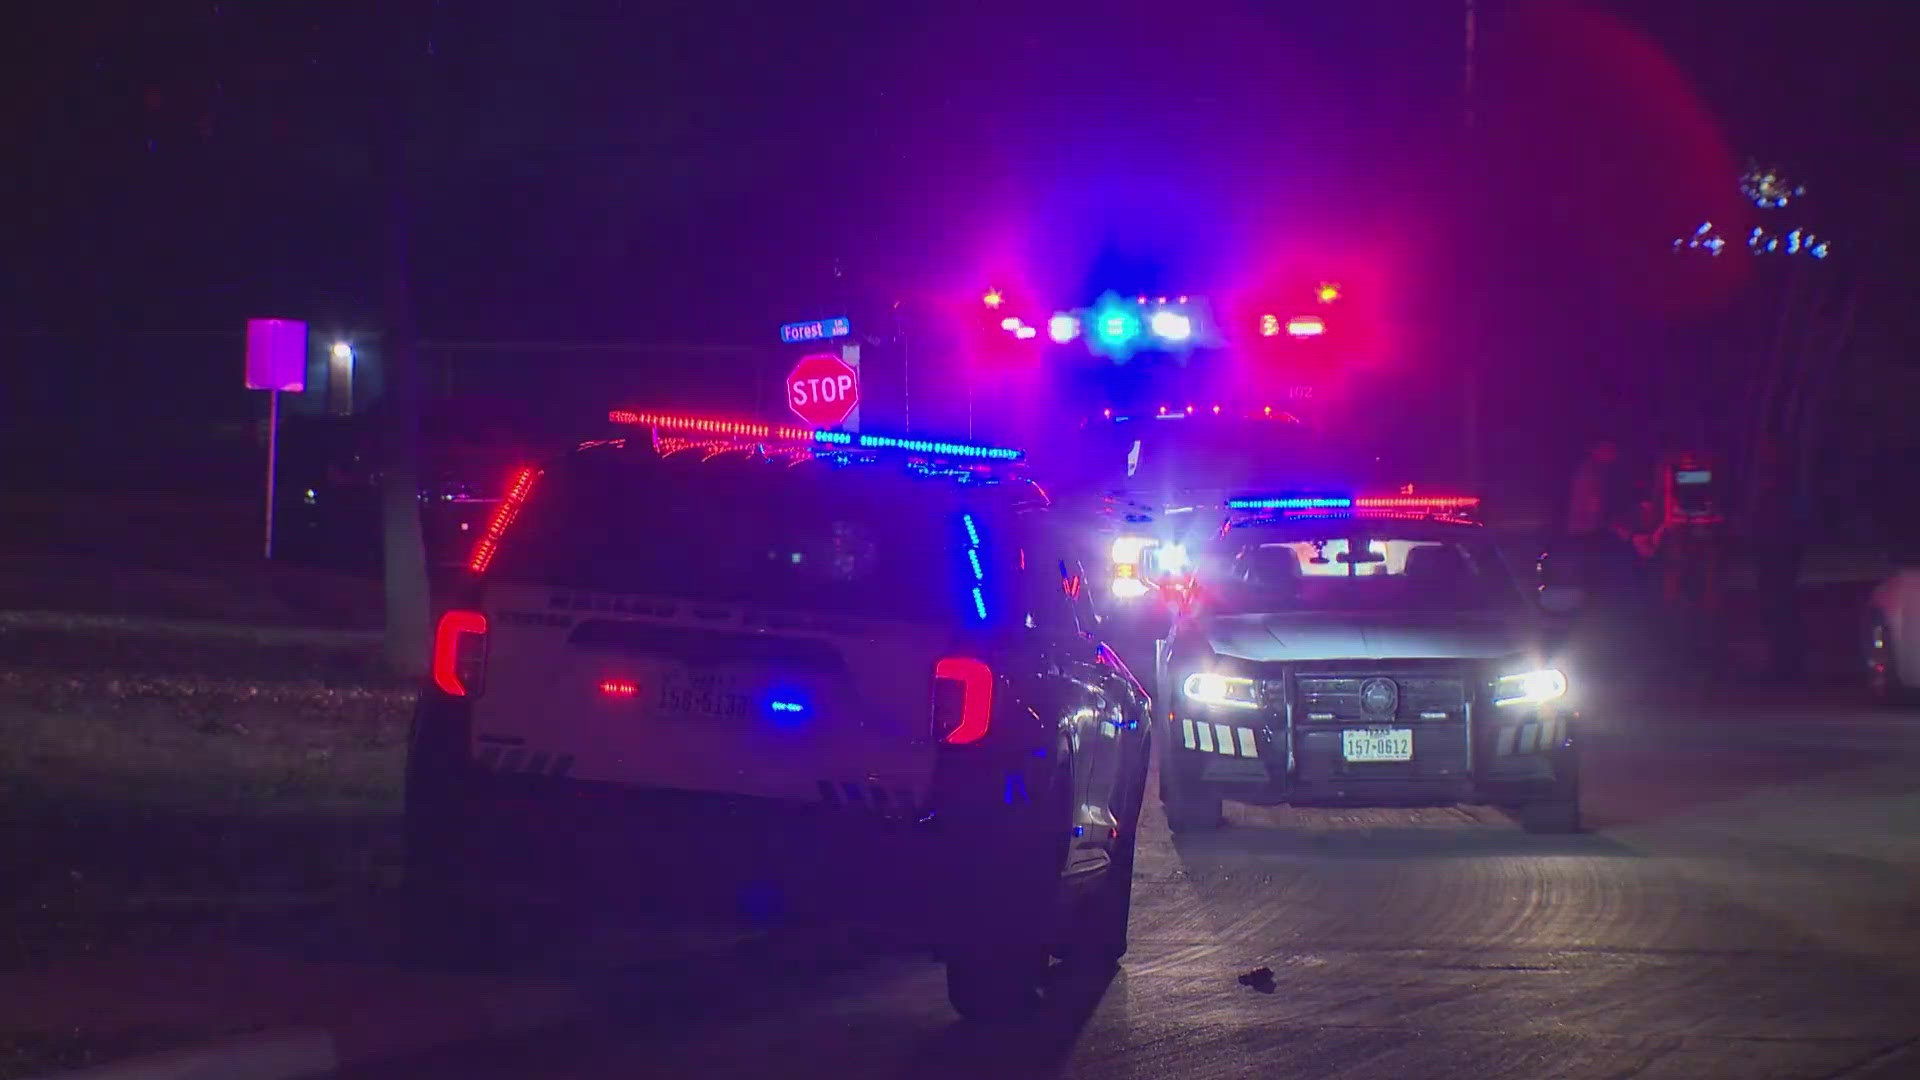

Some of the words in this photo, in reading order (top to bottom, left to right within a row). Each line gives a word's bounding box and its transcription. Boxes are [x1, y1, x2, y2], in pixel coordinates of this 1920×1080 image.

[785, 322, 823, 340] Forest
[793, 375, 852, 406] STOP
[1347, 738, 1408, 756] 157-0612
